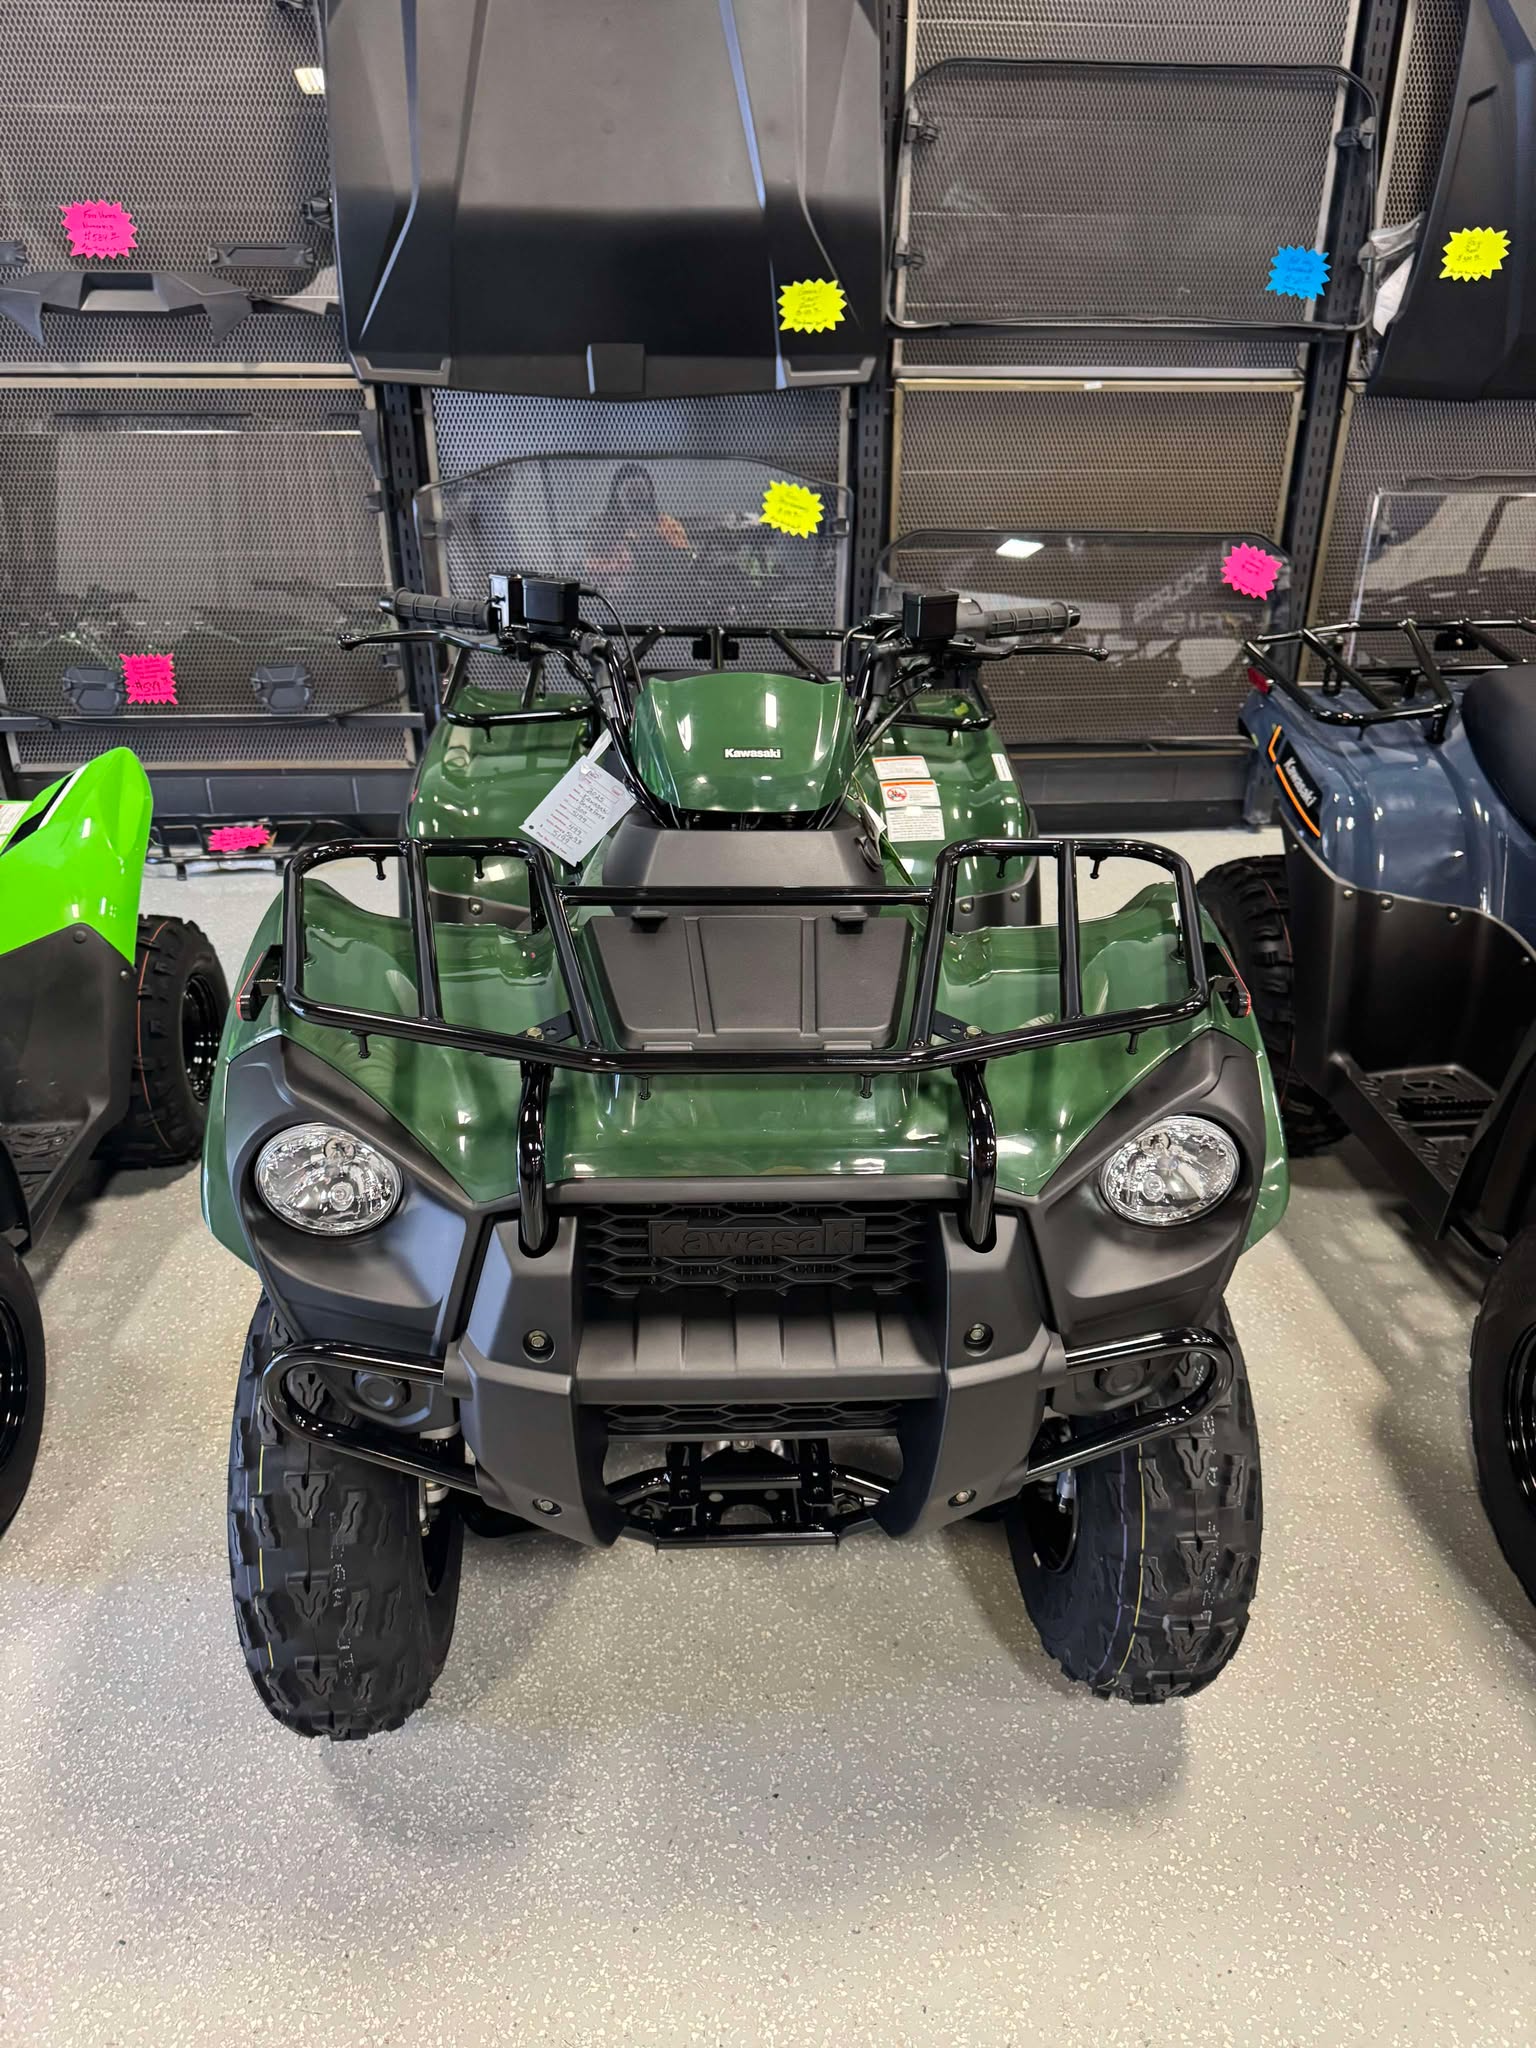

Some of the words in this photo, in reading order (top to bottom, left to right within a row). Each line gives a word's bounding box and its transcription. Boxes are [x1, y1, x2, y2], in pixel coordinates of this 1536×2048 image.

[724, 748, 781, 758] Kawasaki
[1283, 757, 1317, 808] Kawasaki
[586, 787, 605, 802] 2025
[571, 810, 587, 823] 5199
[551, 829, 569, 844] 5199
[652, 1222, 866, 1255] Kawasaki
